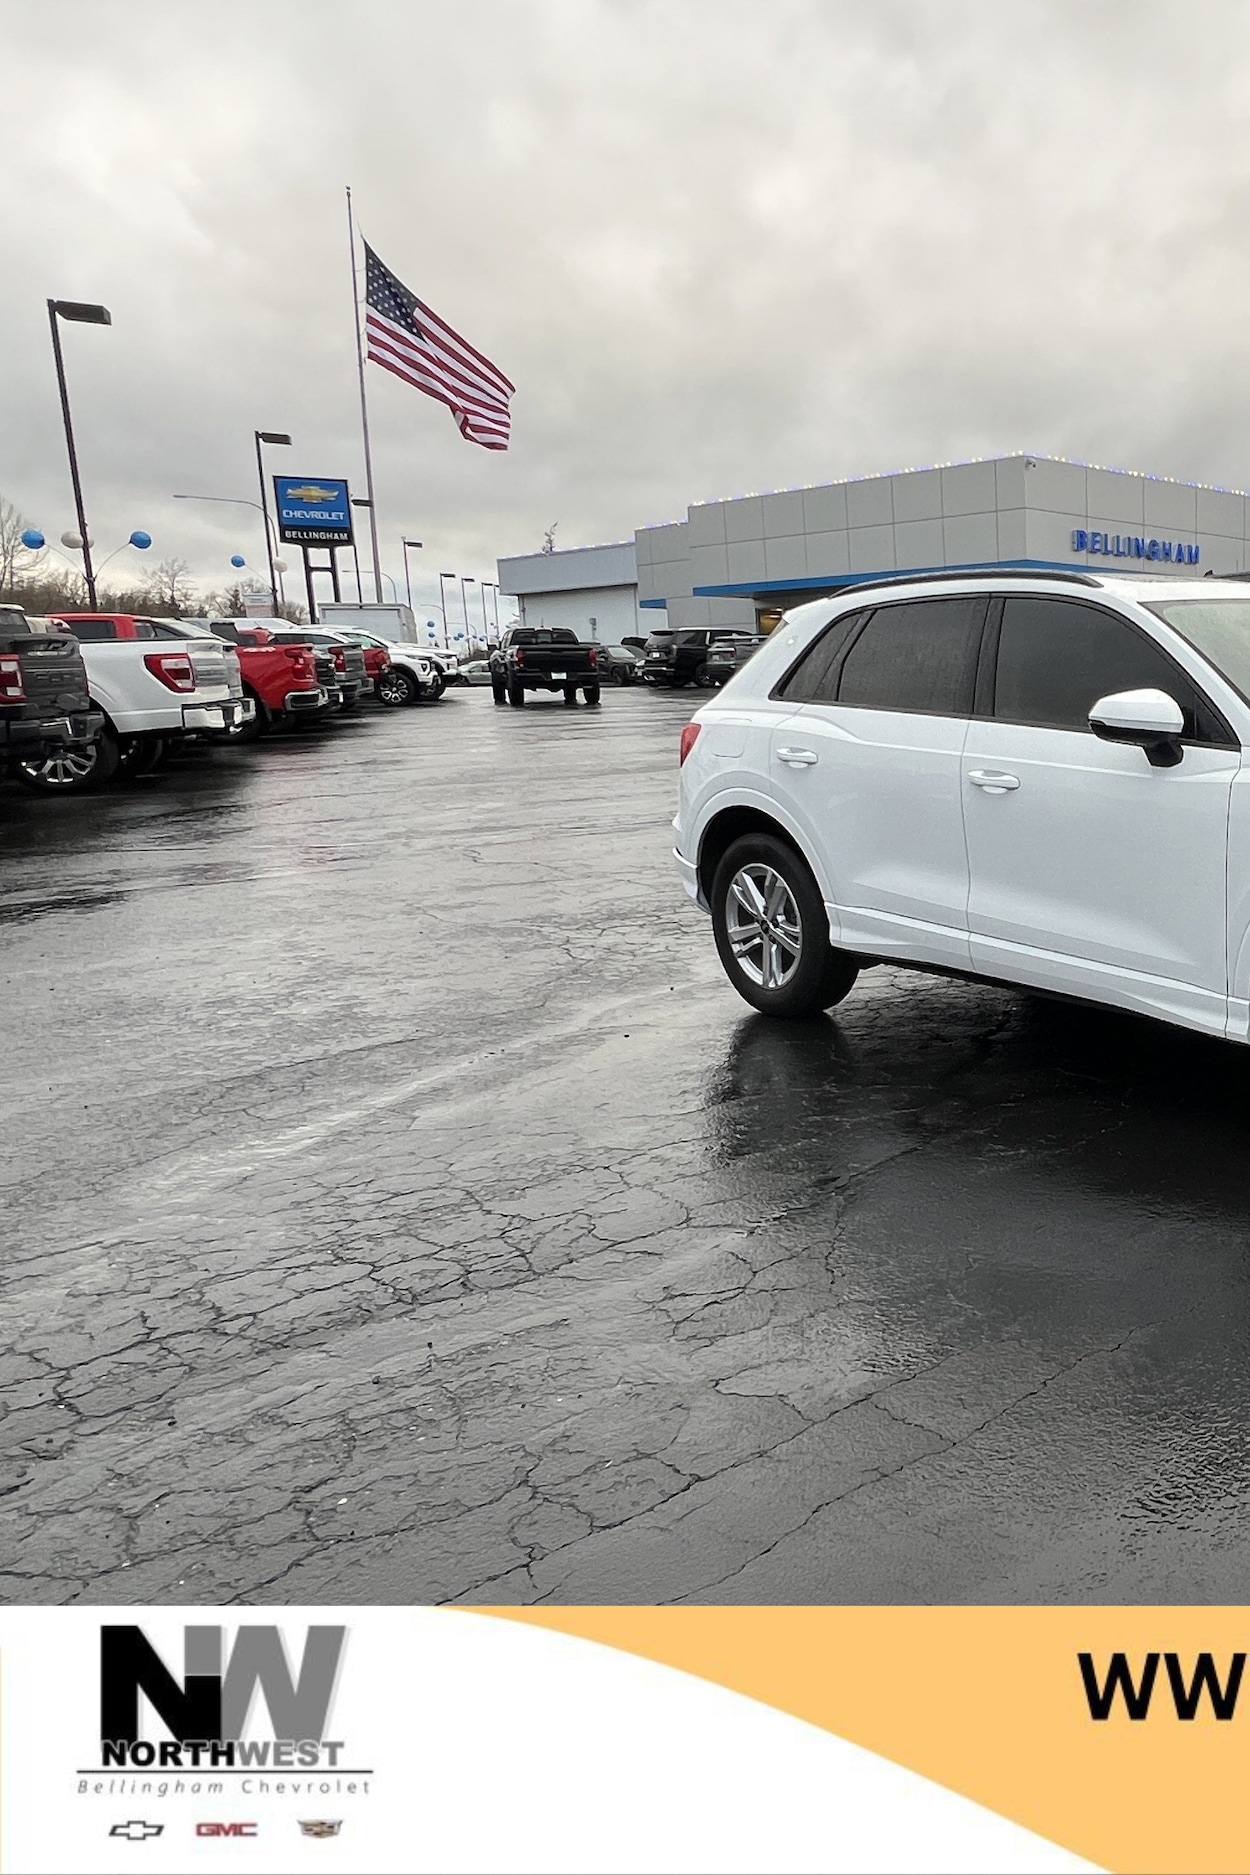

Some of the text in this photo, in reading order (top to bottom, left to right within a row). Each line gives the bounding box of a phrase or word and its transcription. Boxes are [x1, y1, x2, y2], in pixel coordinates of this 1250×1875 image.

[283, 510, 345, 520] CHEVROLET
[285, 531, 348, 540] BELLINGHAM
[1072, 529, 1200, 565] BELLINGHAM
